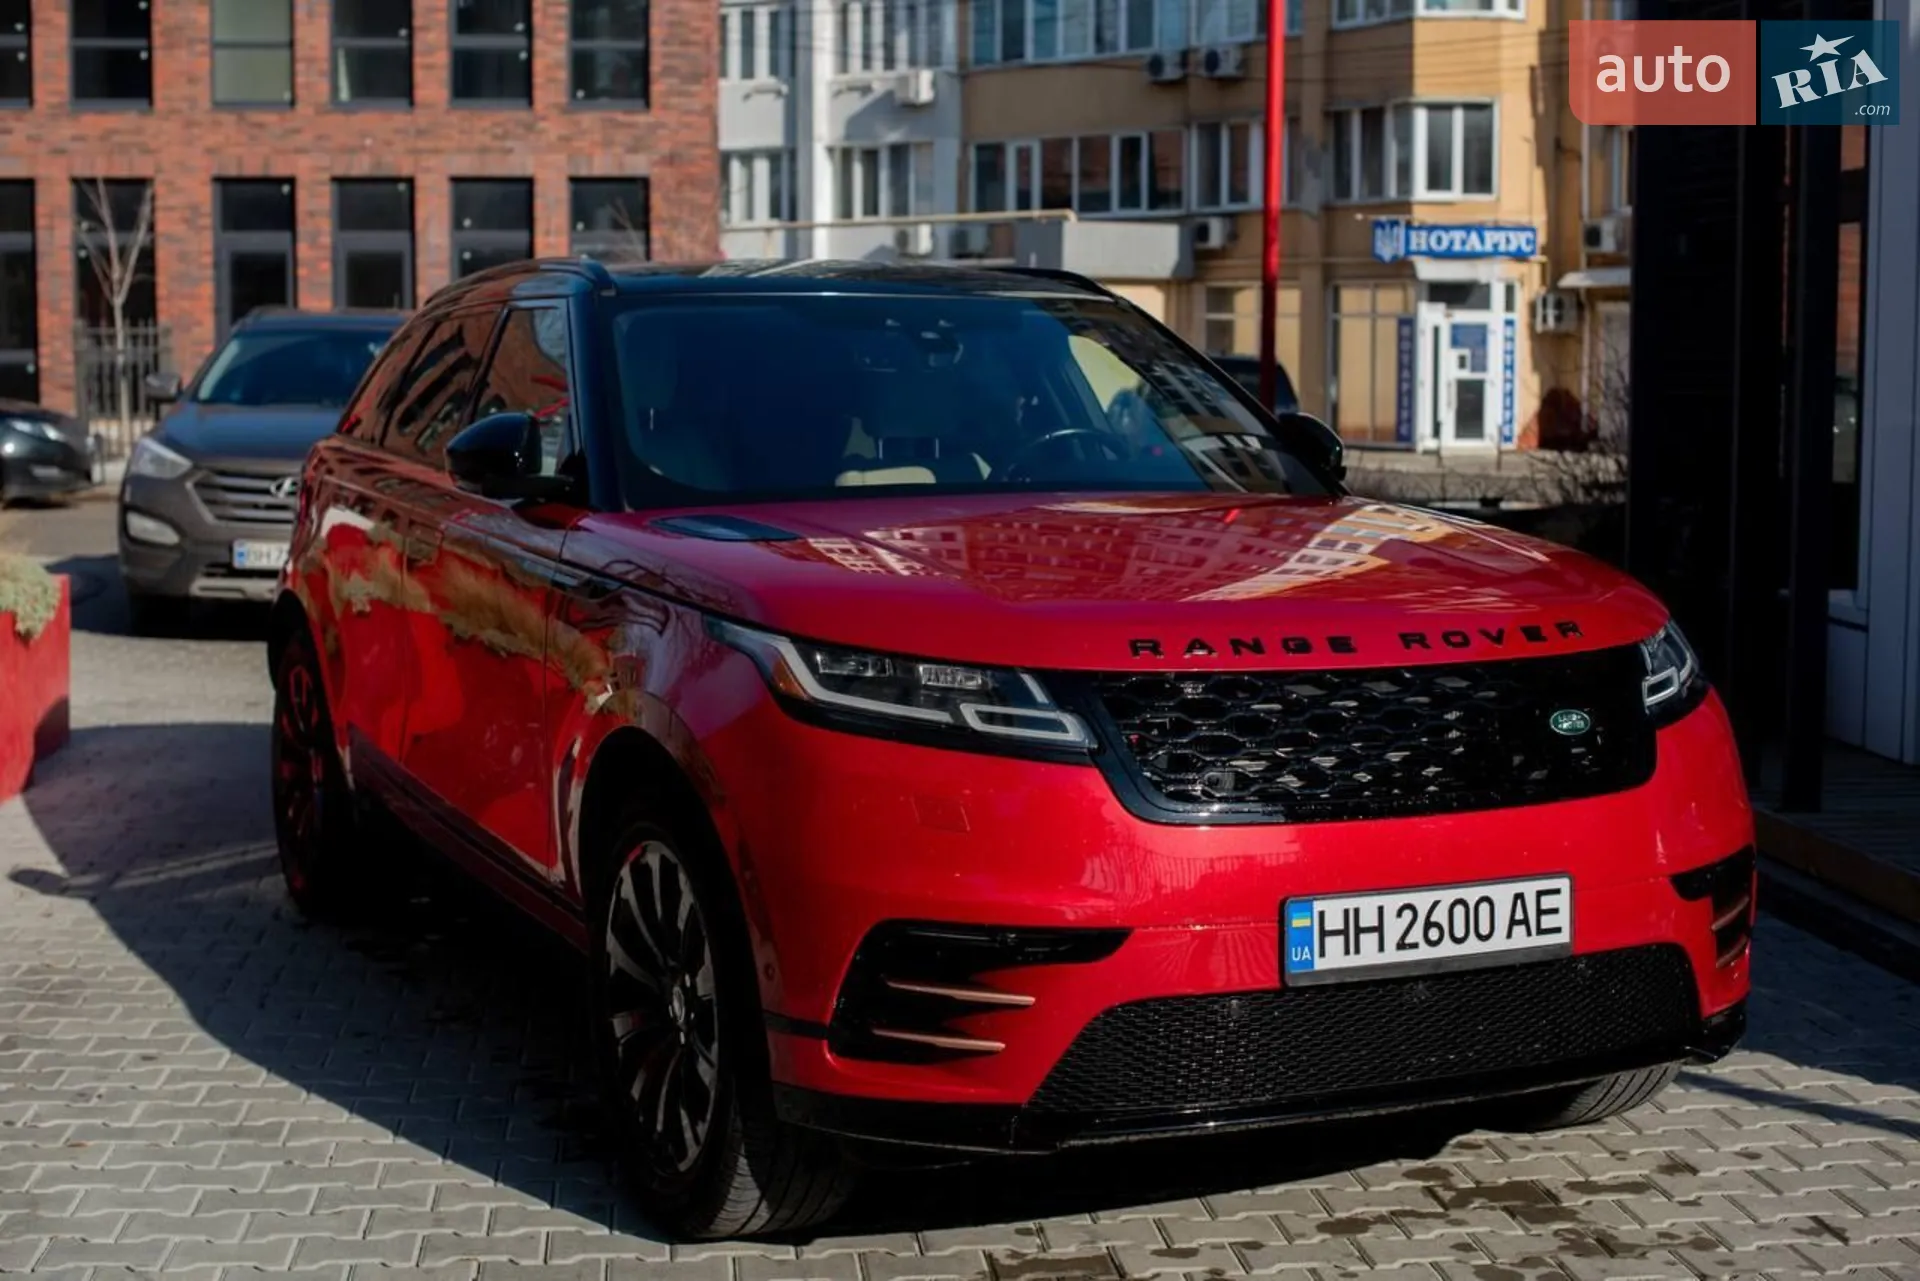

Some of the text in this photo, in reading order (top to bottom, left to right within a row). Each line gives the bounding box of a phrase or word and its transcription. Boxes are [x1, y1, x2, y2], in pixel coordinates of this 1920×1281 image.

[1408, 229, 1534, 253] НОТАРІУС
[1128, 622, 1585, 658] RANGE ROVER
[1318, 888, 1562, 958] HH 2600 AE
[1291, 946, 1311, 961] UA
